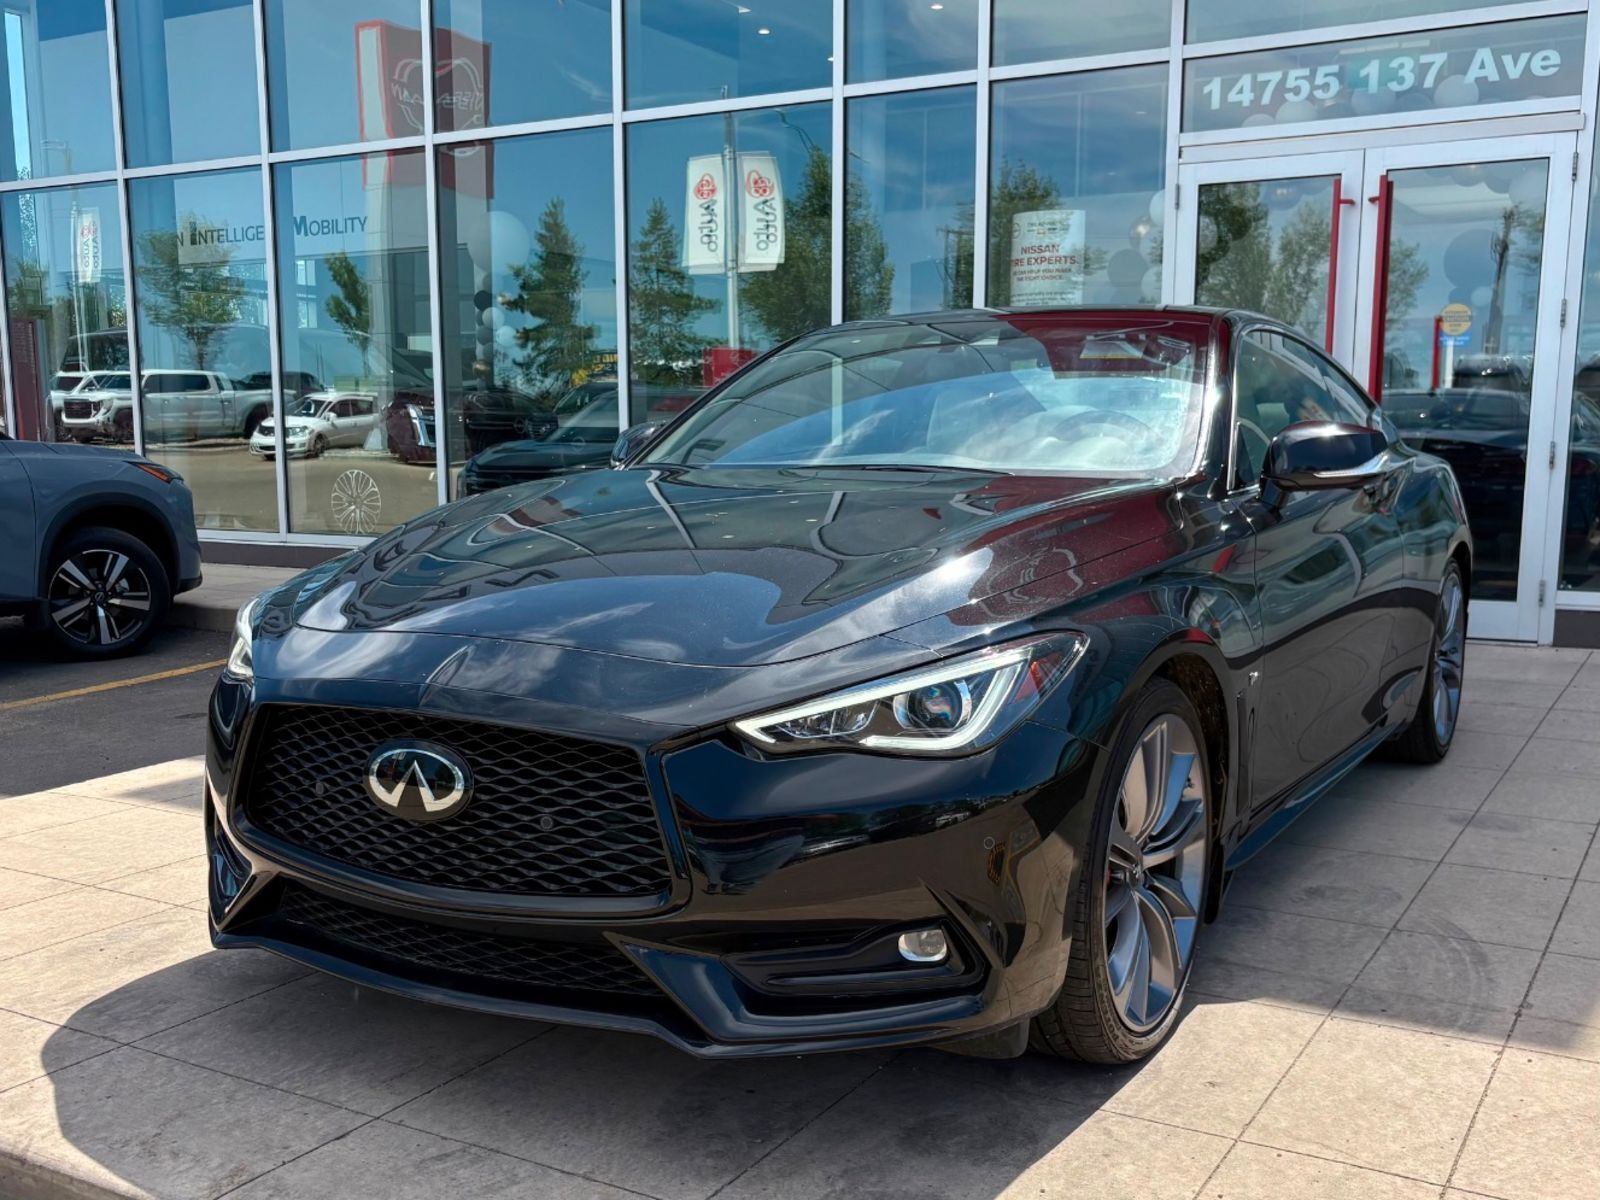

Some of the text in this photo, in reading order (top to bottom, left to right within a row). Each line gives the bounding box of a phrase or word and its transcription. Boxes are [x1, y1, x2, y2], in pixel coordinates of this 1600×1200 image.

[1203, 47, 1561, 110] 14755 137 Ave
[190, 221, 265, 246] INTELLIGE
[293, 215, 368, 237] MOBILITY
[1020, 244, 1060, 255] NISSAN
